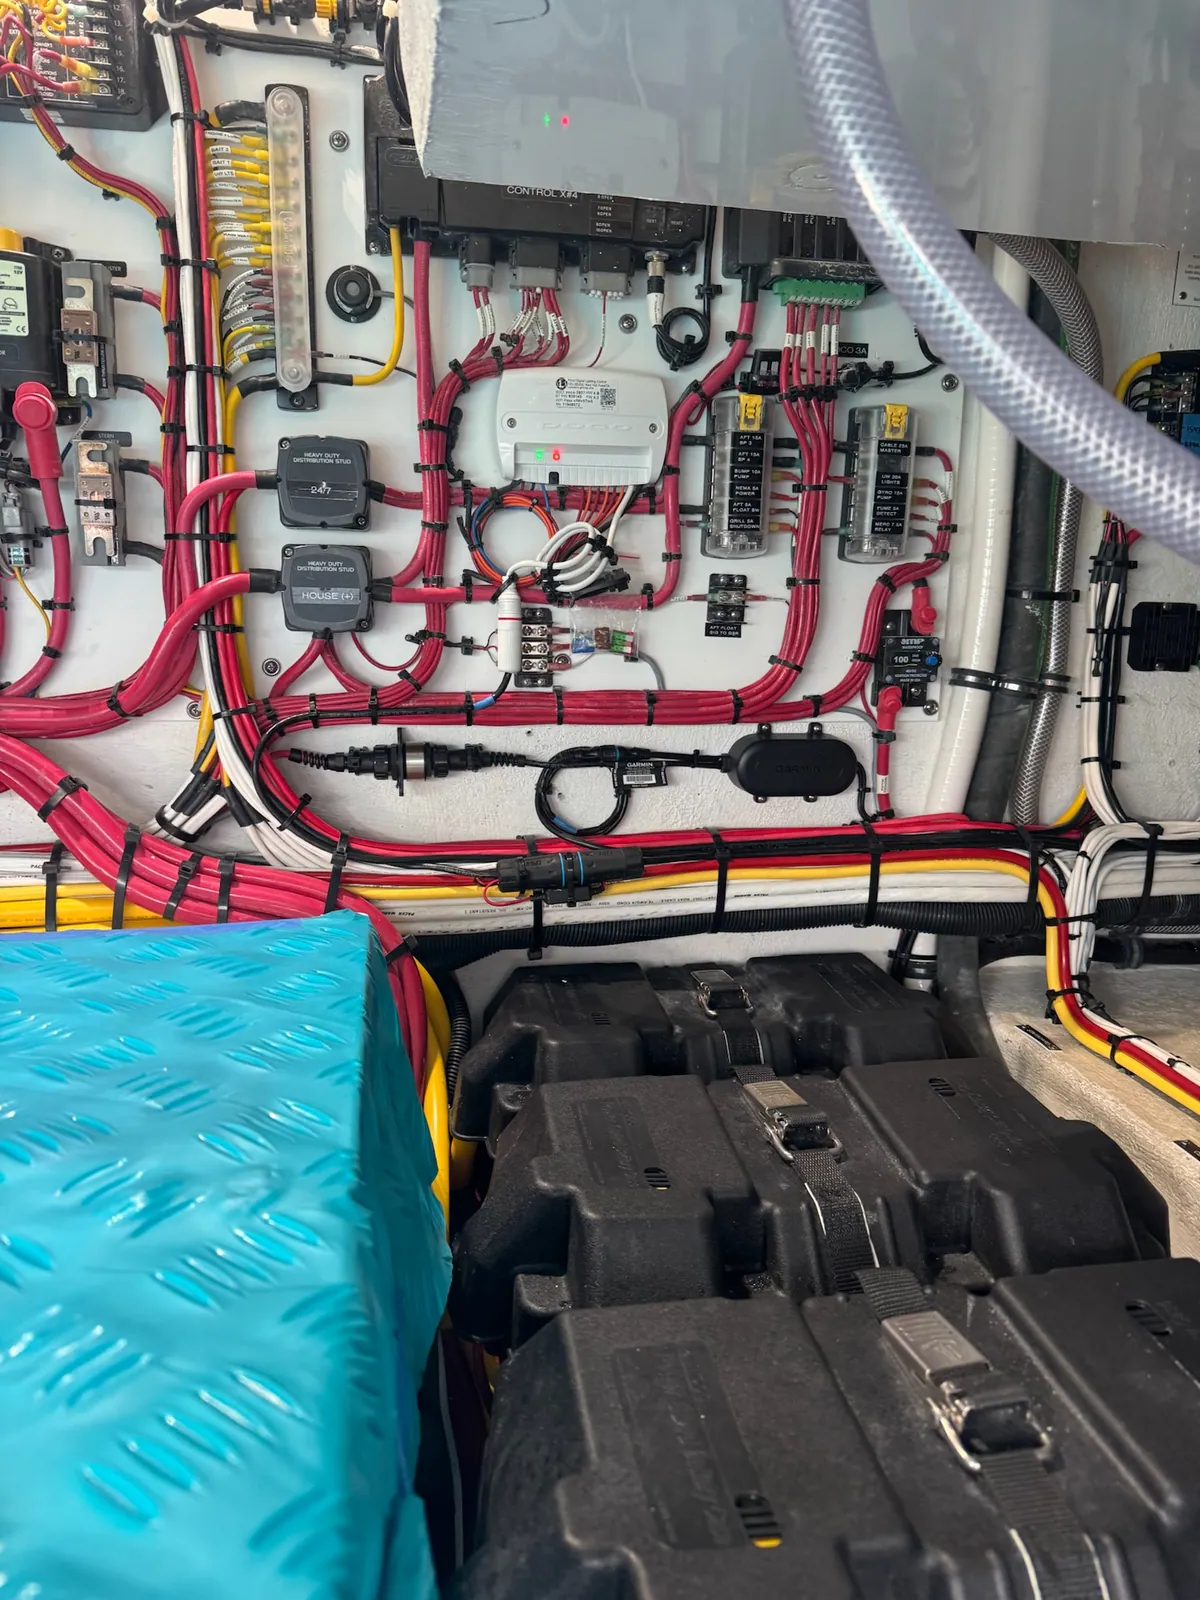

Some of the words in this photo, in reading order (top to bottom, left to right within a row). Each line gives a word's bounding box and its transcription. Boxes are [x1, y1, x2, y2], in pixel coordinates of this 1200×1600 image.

[506, 186, 557, 198] CONTROL
[560, 190, 578, 199] X#4
[856, 346, 868, 354] 3A
[310, 486, 332, 494] 24/7
[775, 765, 820, 774] GARMIN
